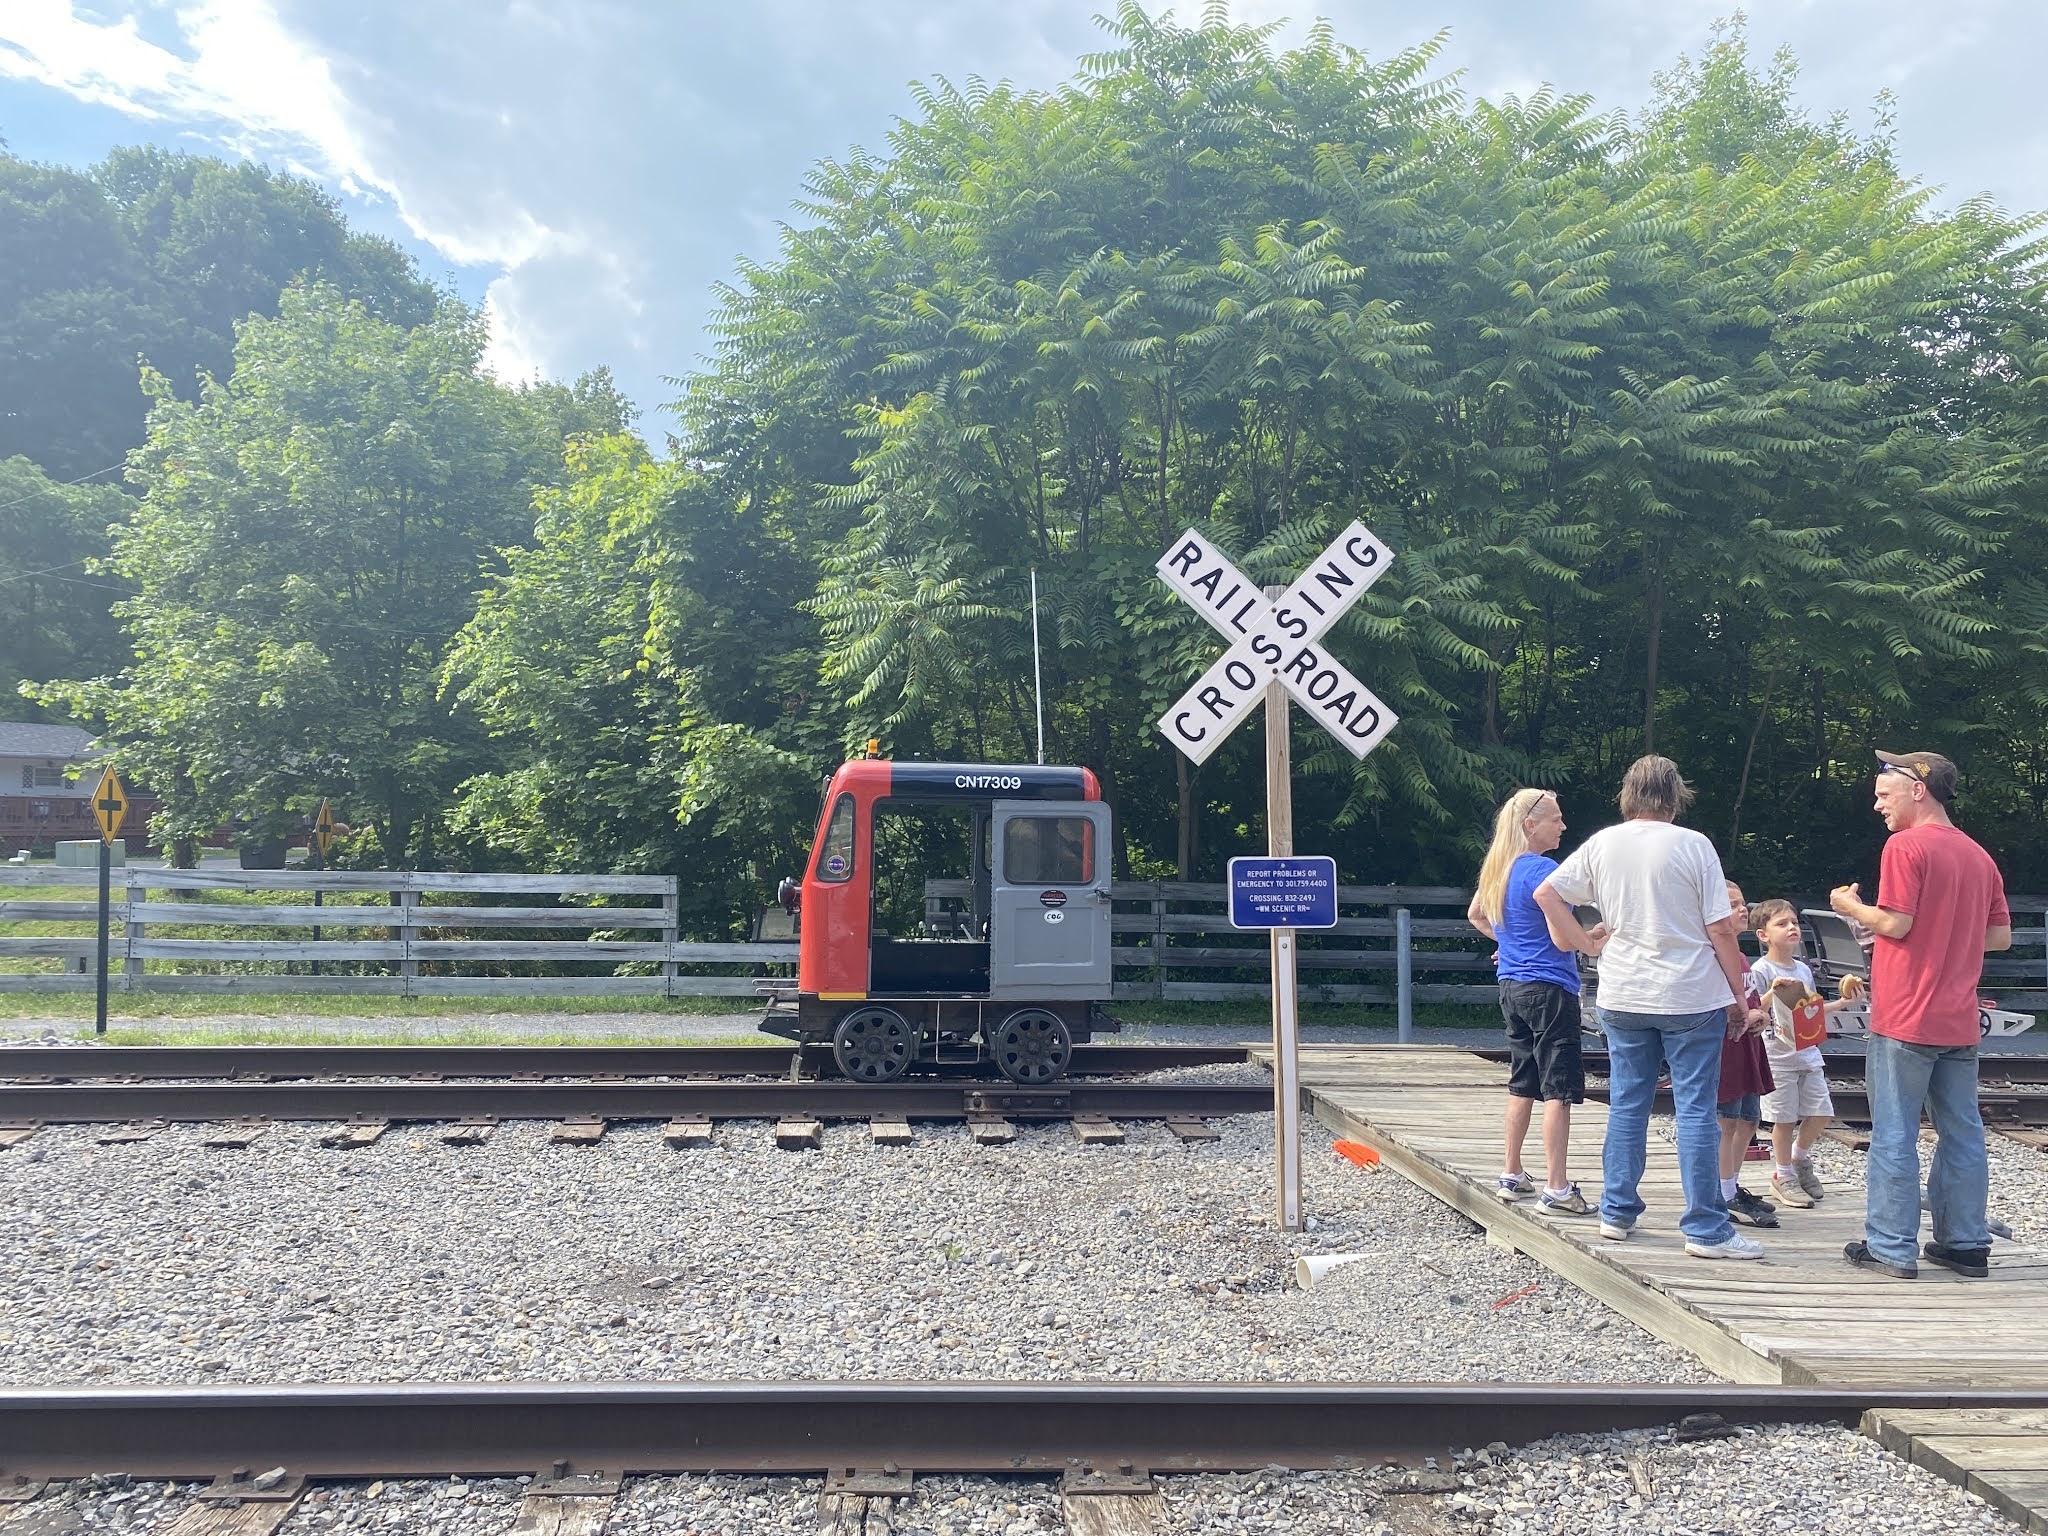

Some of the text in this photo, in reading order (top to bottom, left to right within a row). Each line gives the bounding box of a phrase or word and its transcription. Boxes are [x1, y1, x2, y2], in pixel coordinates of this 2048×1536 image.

[1168, 540, 1379, 738] RAIL ROAD
[1174, 537, 1378, 743] CROSSING
[955, 775, 1021, 789] CN17309
[1286, 880, 1327, 888] 301.759.4400
[1742, 972, 1756, 988] IKE
